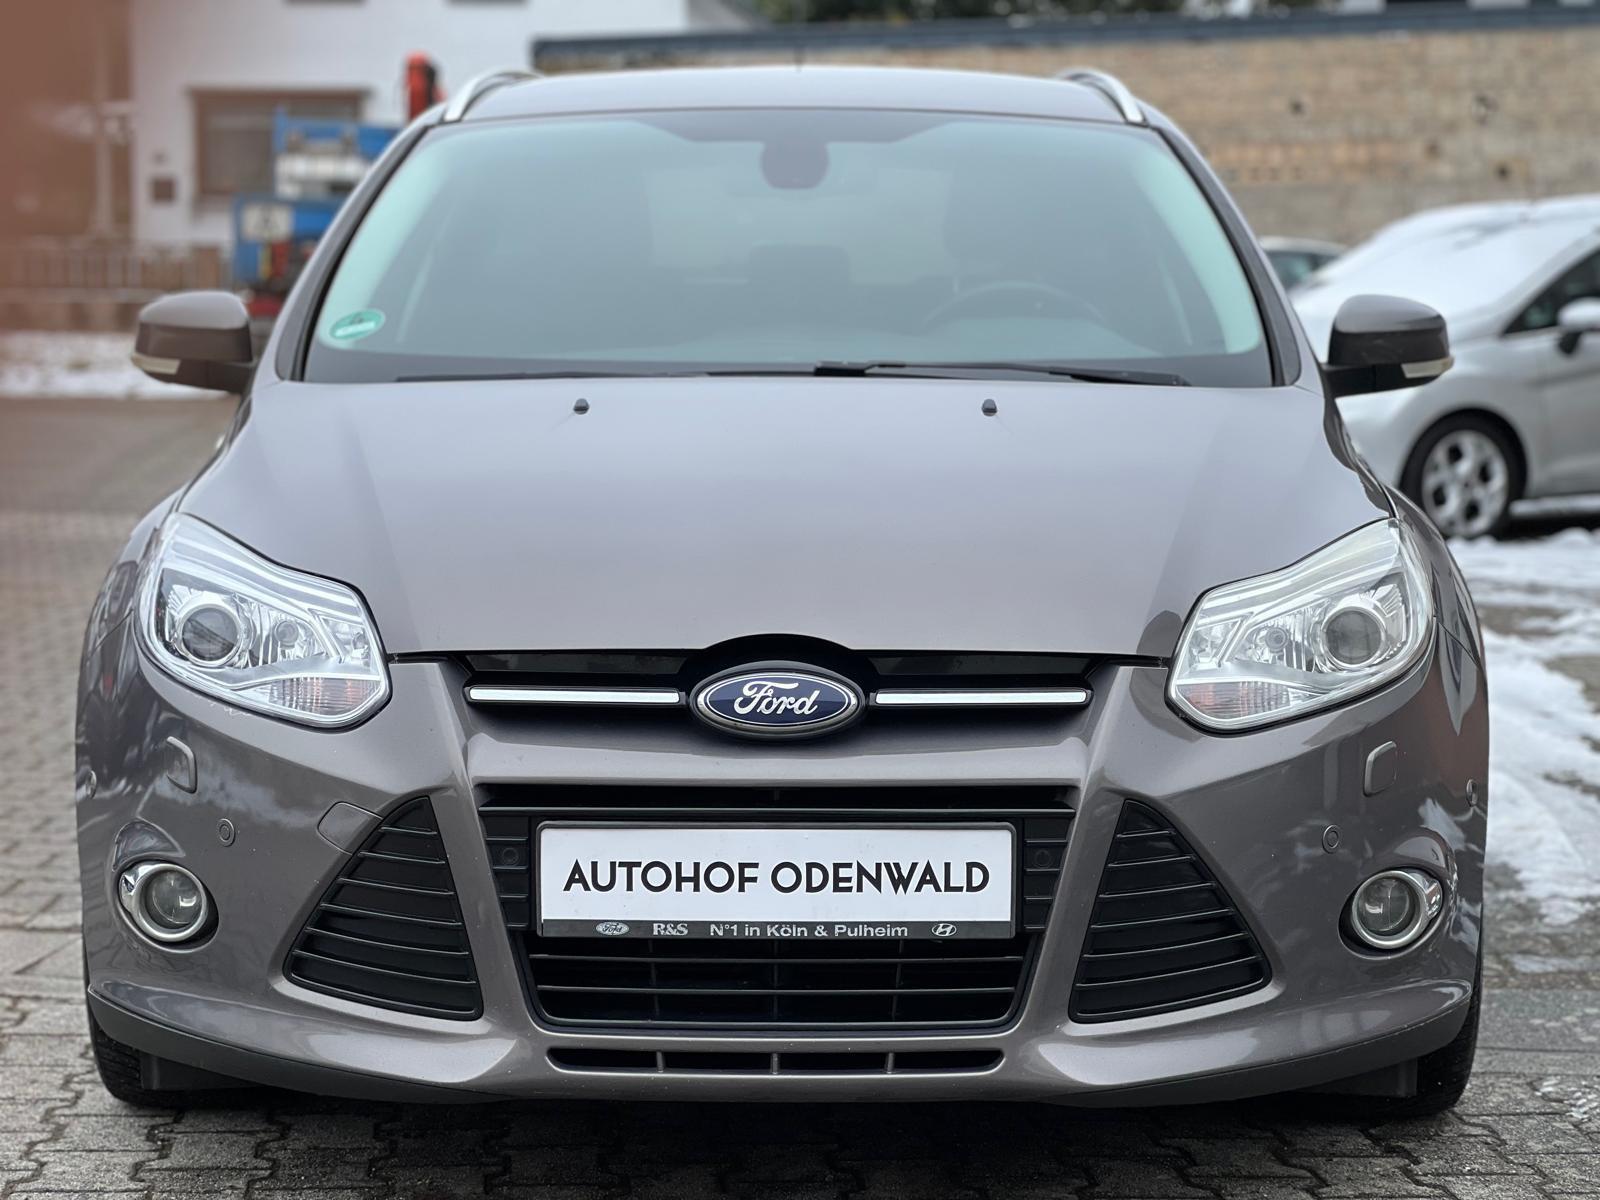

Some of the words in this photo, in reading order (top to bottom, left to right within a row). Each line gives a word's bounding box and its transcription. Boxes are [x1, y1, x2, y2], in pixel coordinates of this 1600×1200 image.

[733, 680, 821, 715] Ford
[563, 858, 760, 894] AUTOHOF
[770, 859, 990, 895] ODENWALD
[653, 922, 688, 936] R&S
[745, 924, 760, 936] in
[767, 924, 808, 937] Köln
[814, 924, 828, 937] &
[834, 924, 908, 937] Pulheim
